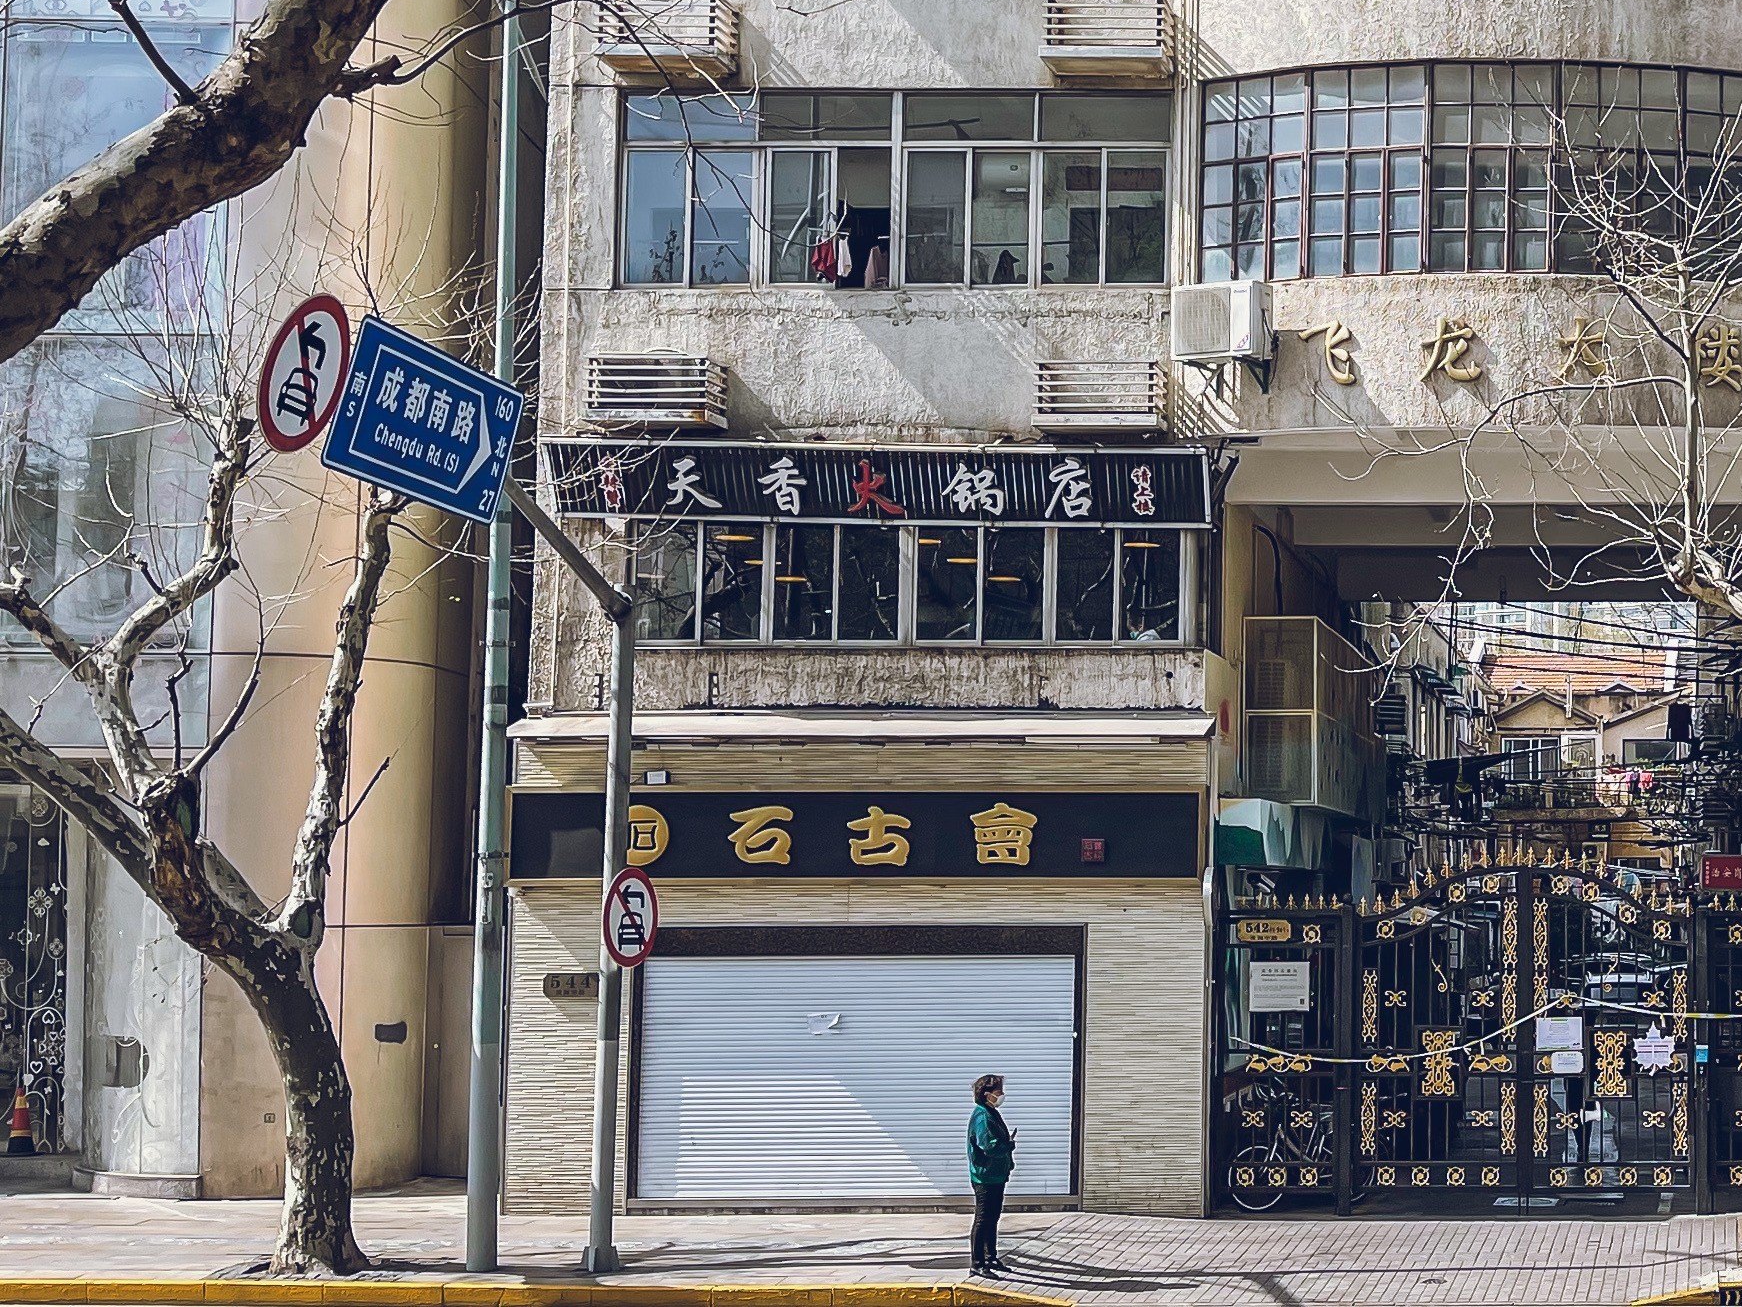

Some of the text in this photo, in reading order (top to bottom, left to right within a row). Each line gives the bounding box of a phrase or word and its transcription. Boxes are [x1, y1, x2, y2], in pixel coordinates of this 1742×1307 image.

[1298, 317, 1742, 391] 飞龙大楼
[350, 371, 368, 396] 南
[346, 401, 355, 418] S
[376, 367, 476, 445] 成都南路
[494, 396, 513, 422] 160
[374, 423, 460, 474] Chengdu Rd. (S)
[494, 436, 507, 458] 北
[491, 462, 499, 478] N
[664, 455, 1096, 519] 天香火锅店
[478, 490, 495, 514] 27
[1245, 922, 1270, 934] 542
[550, 975, 591, 989] 544
